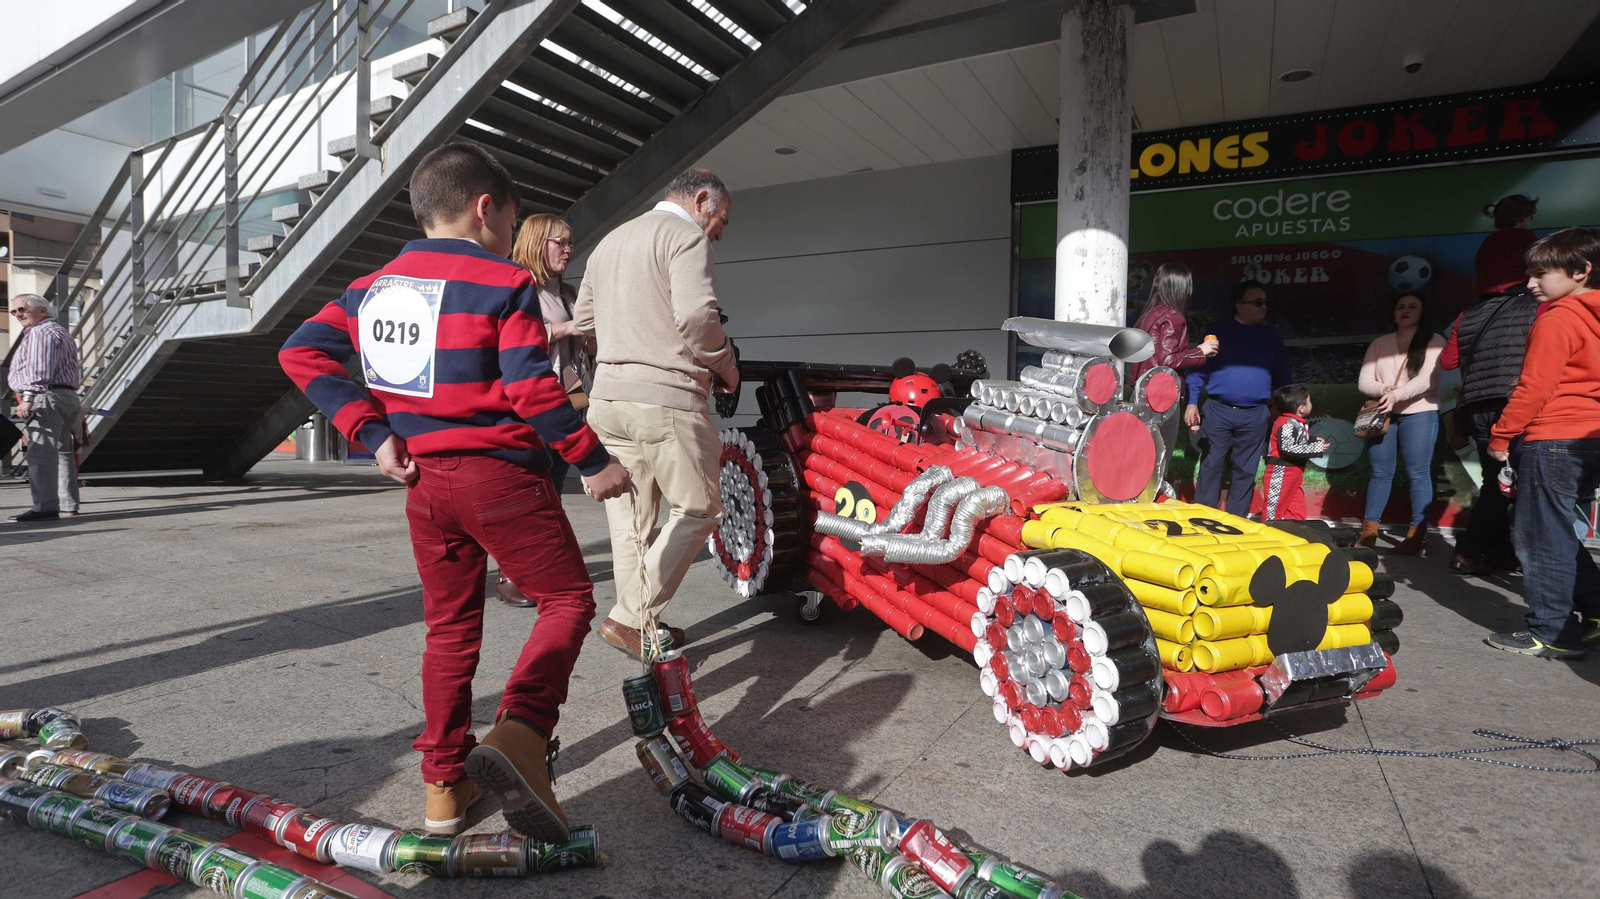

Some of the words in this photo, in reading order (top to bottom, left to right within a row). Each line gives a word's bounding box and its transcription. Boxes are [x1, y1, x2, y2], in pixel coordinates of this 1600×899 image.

[1130, 130, 1270, 179] ONES
[1293, 98, 1557, 161] JOKER
[1213, 188, 1352, 221] codere
[1234, 216, 1352, 239] APUESTAS
[1230, 253, 1274, 265] SALON
[1295, 249, 1343, 261] JUEGO
[372, 318, 421, 346] 0219
